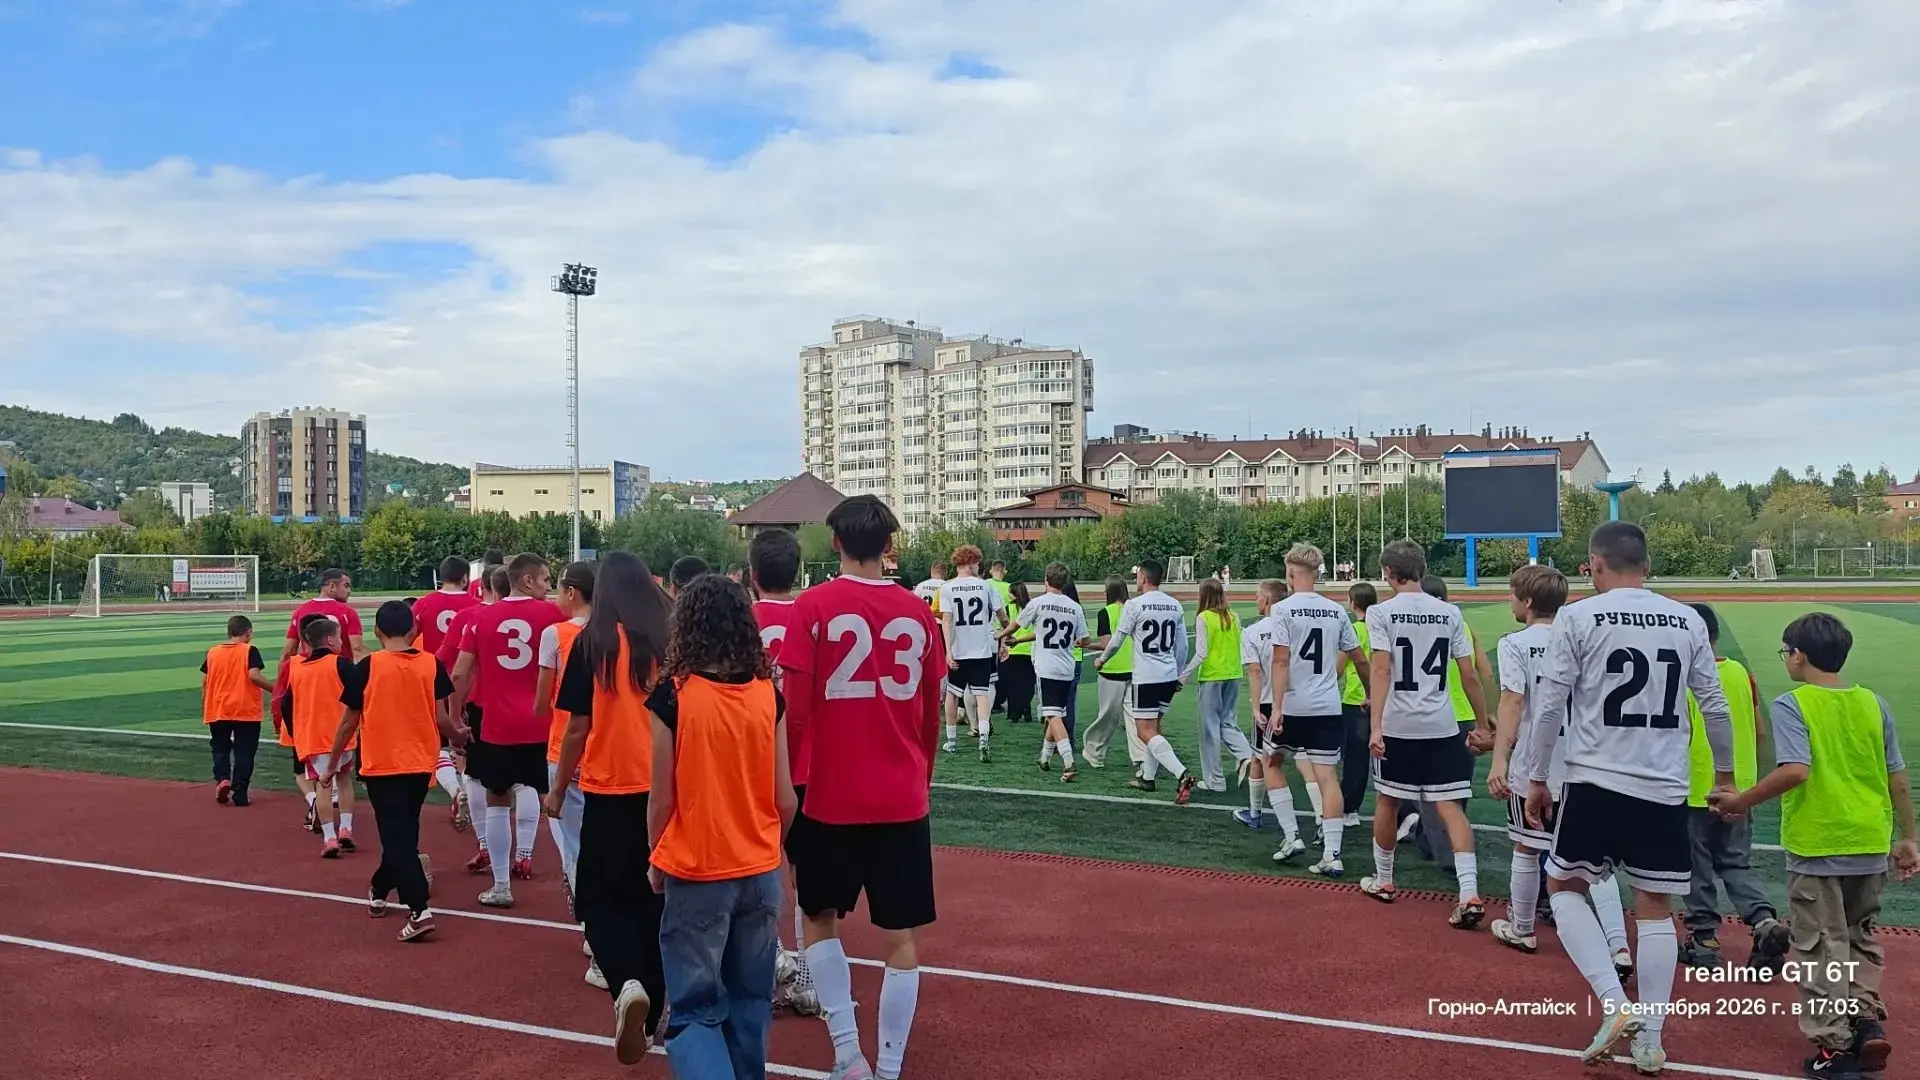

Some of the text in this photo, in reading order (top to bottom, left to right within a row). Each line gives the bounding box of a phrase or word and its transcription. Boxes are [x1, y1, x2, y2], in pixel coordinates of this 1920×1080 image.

[953, 596, 984, 626] 12
[1289, 608, 1339, 619] РУБЦОВСК
[1390, 613, 1450, 626] РУБЦОВСК
[1593, 612, 1689, 631] РУБЦОВСК
[496, 618, 533, 671] 3
[1042, 617, 1074, 650] 23
[1142, 619, 1176, 653] 20
[825, 613, 928, 701] 23
[1299, 628, 1323, 675] 4
[1394, 637, 1450, 692] 14
[1603, 647, 1682, 729] 21
